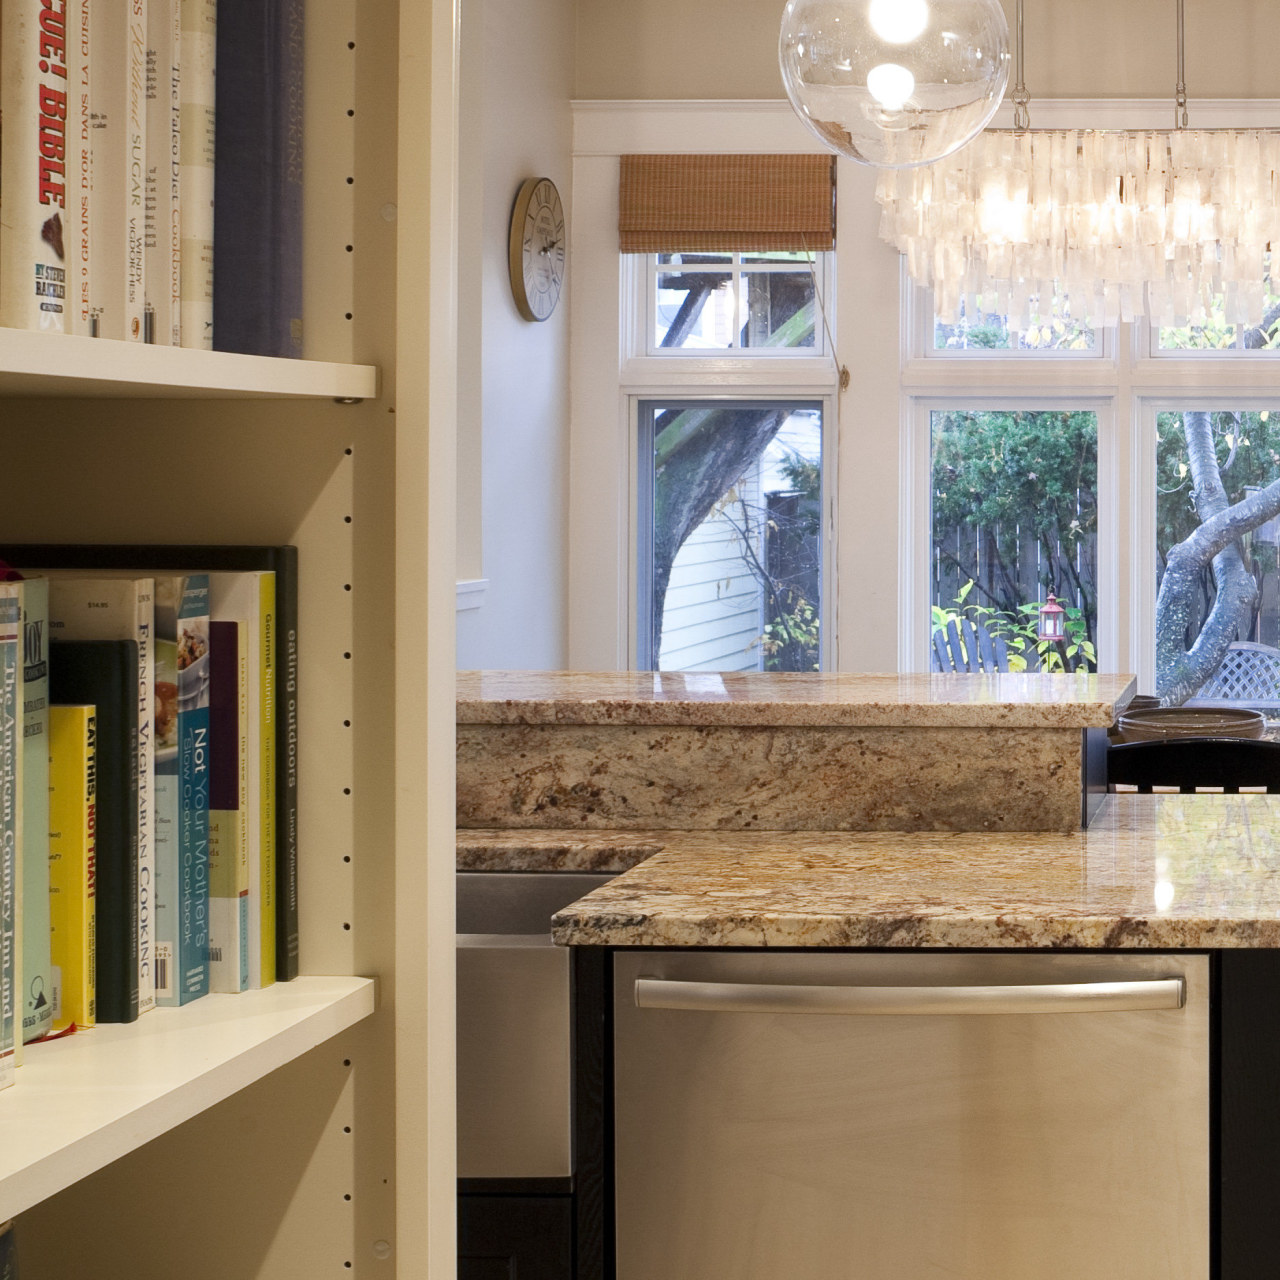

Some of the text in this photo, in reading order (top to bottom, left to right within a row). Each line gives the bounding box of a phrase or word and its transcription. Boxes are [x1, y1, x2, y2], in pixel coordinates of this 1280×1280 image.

[39, 83, 68, 209] BIBLE
[81, 66, 89, 86] LA
[81, 93, 89, 140] DANS
[128, 23, 145, 131] Without
[81, 196, 89, 261] GRAINS
[131, 134, 141, 206] SUGAR
[171, 63, 181, 304] The Paleo Diet Cookbook
[81, 282, 89, 321] LES
[287, 630, 297, 788] eating outdoors
[2, 662, 16, 1019] The American Country Inn and
[86, 716, 96, 898] EAT THIS, NOT THAT!
[138, 623, 150, 979] FRENCH VEGETARIAN COOKING
[183, 737, 192, 945] Slow Cooker Cookbook
[193, 727, 209, 947] Not Your Mother's
